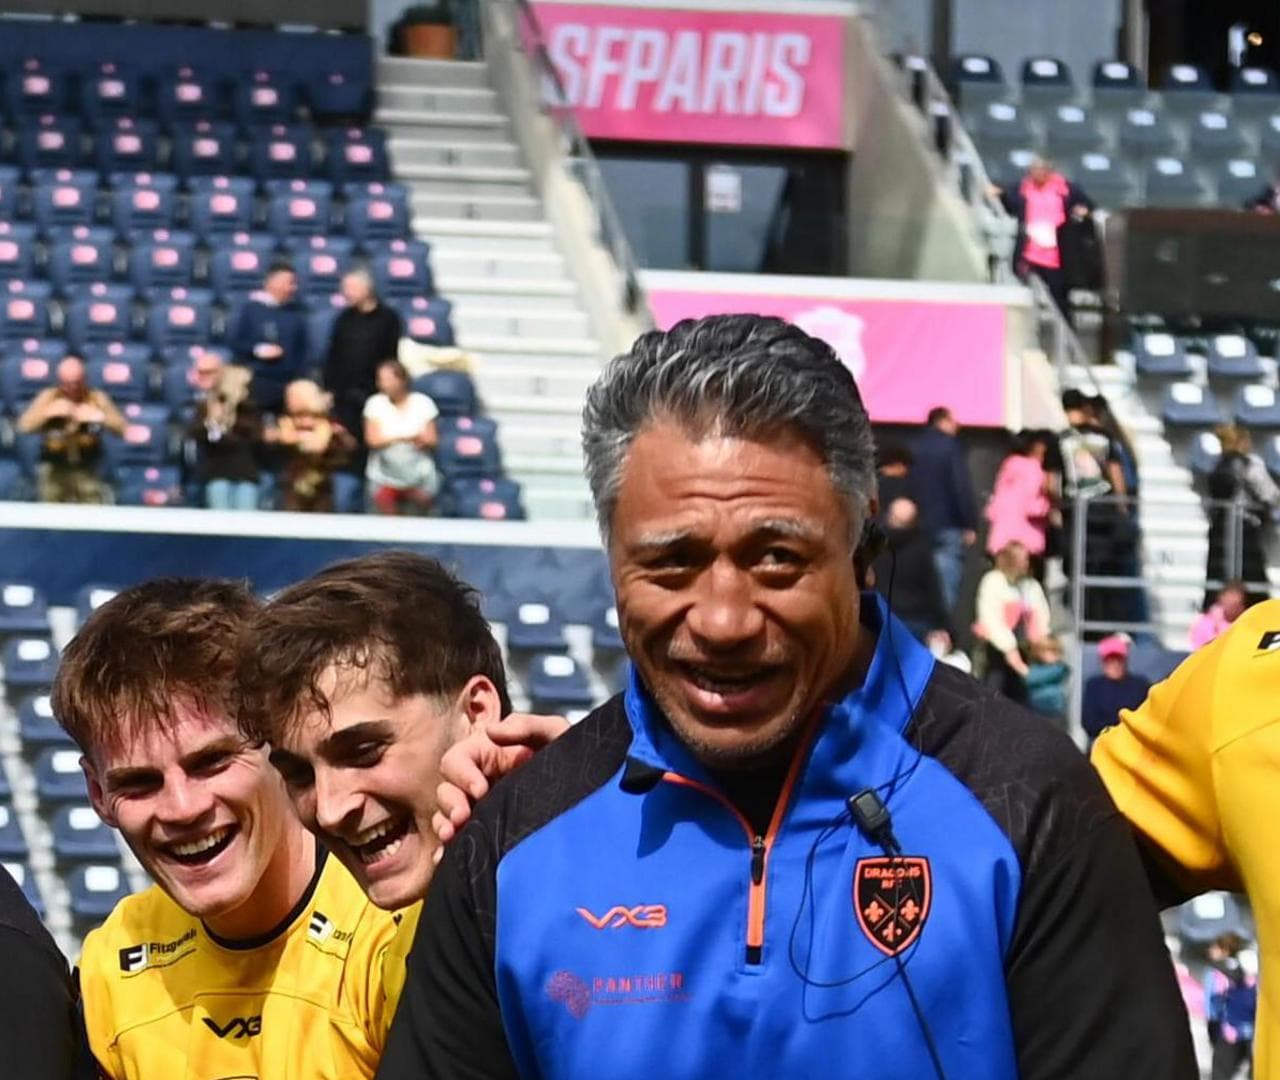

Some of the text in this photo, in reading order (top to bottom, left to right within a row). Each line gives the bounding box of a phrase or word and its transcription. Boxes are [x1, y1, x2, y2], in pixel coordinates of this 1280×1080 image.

[542, 23, 812, 118] SFPARIS
[881, 879, 903, 889] RF
[576, 903, 667, 930] VX3
